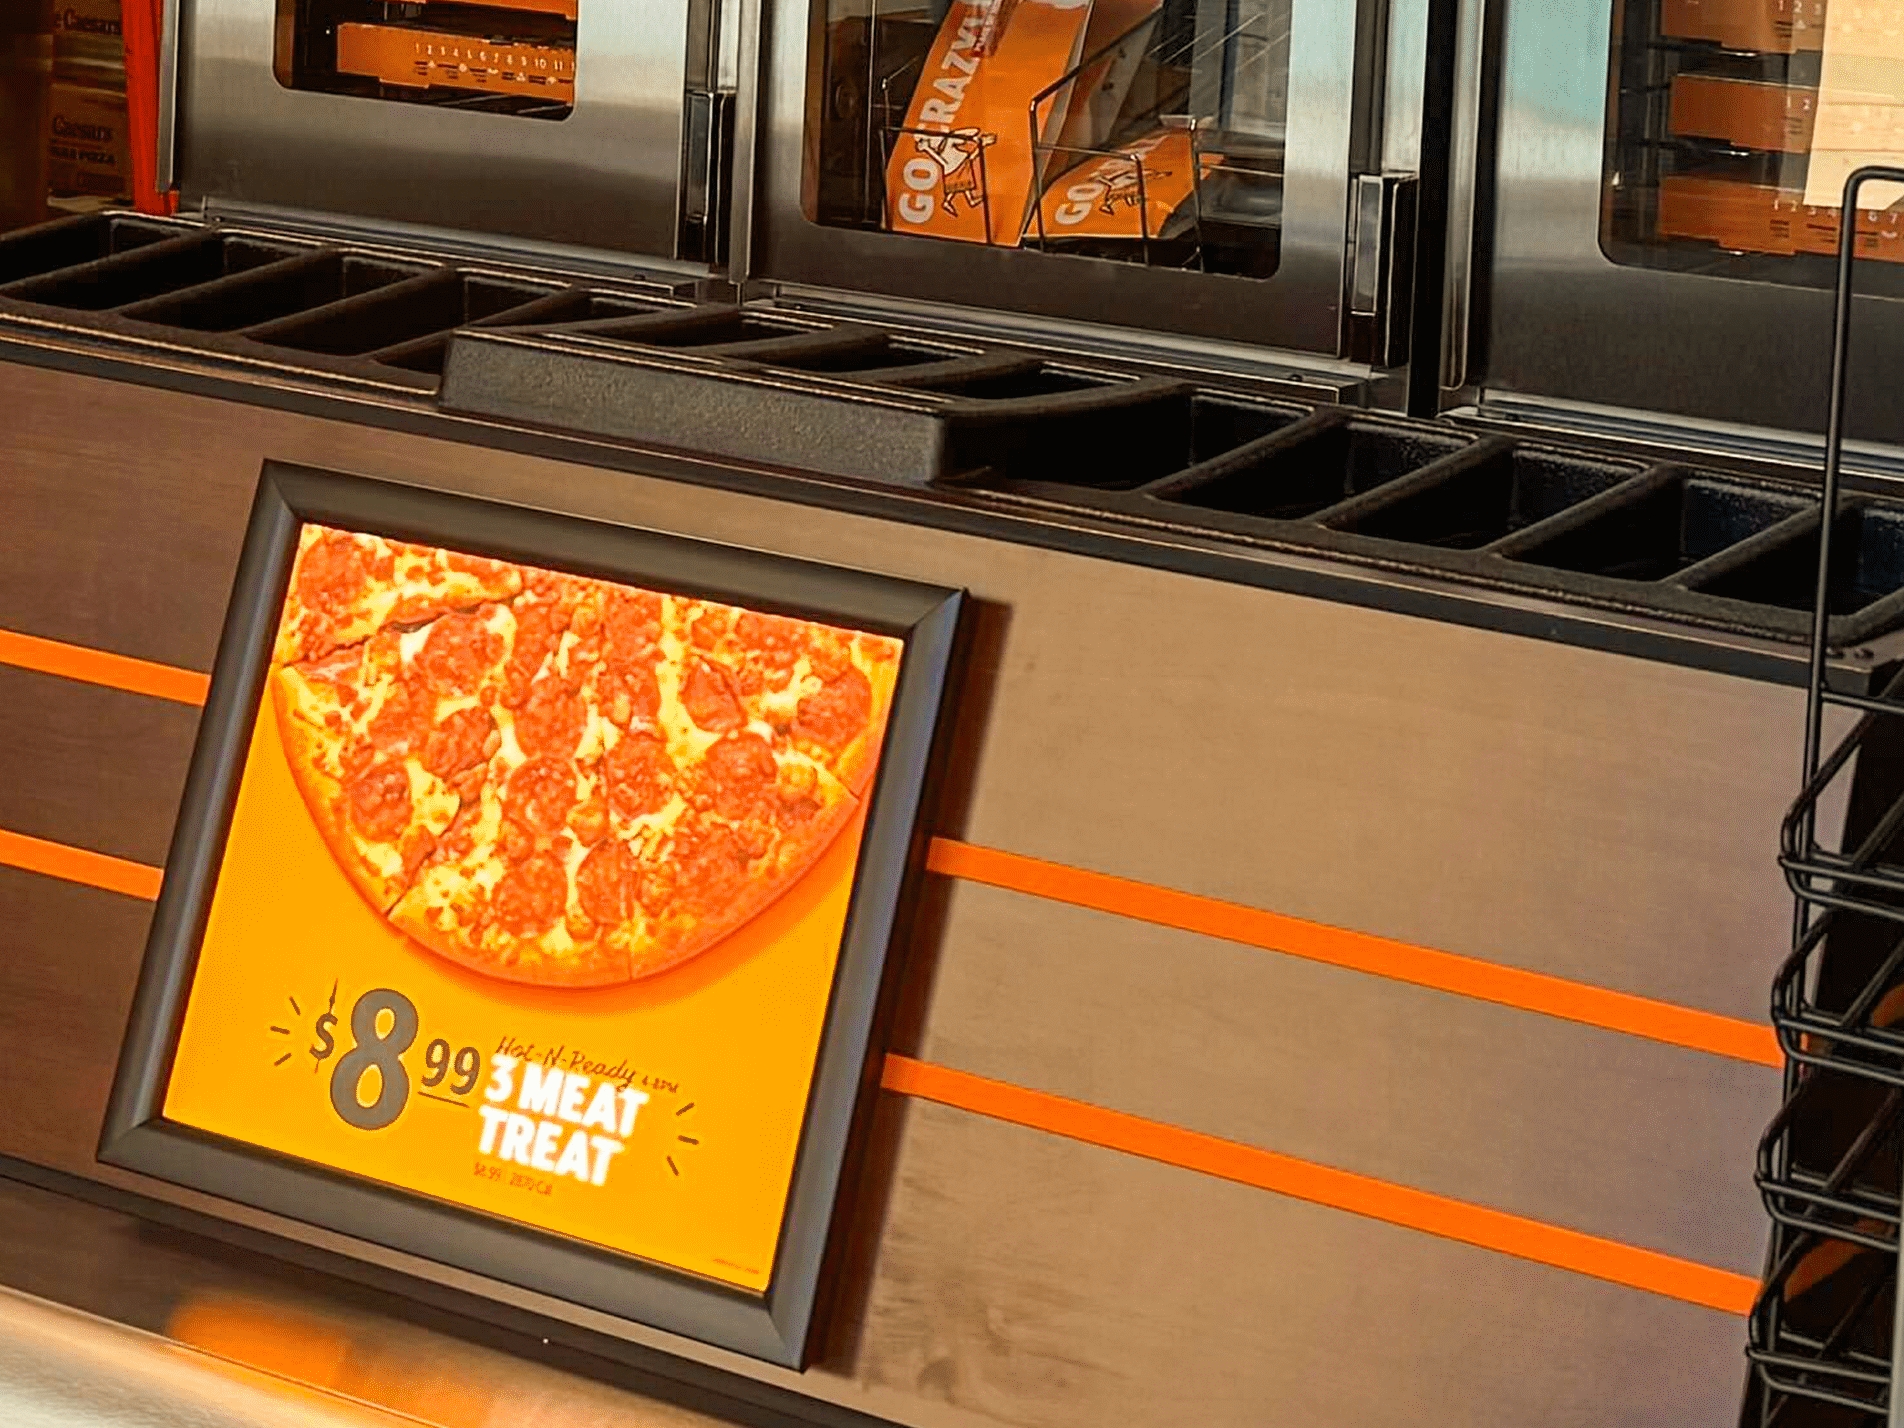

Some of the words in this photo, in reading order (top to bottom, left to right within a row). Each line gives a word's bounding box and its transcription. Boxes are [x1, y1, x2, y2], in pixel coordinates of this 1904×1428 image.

[898, 158, 939, 224] GO
[1055, 183, 1104, 226] GO
[484, 1052, 518, 1104] 3
[518, 1061, 651, 1139] MEAT
[477, 1105, 625, 1187] TREAT
